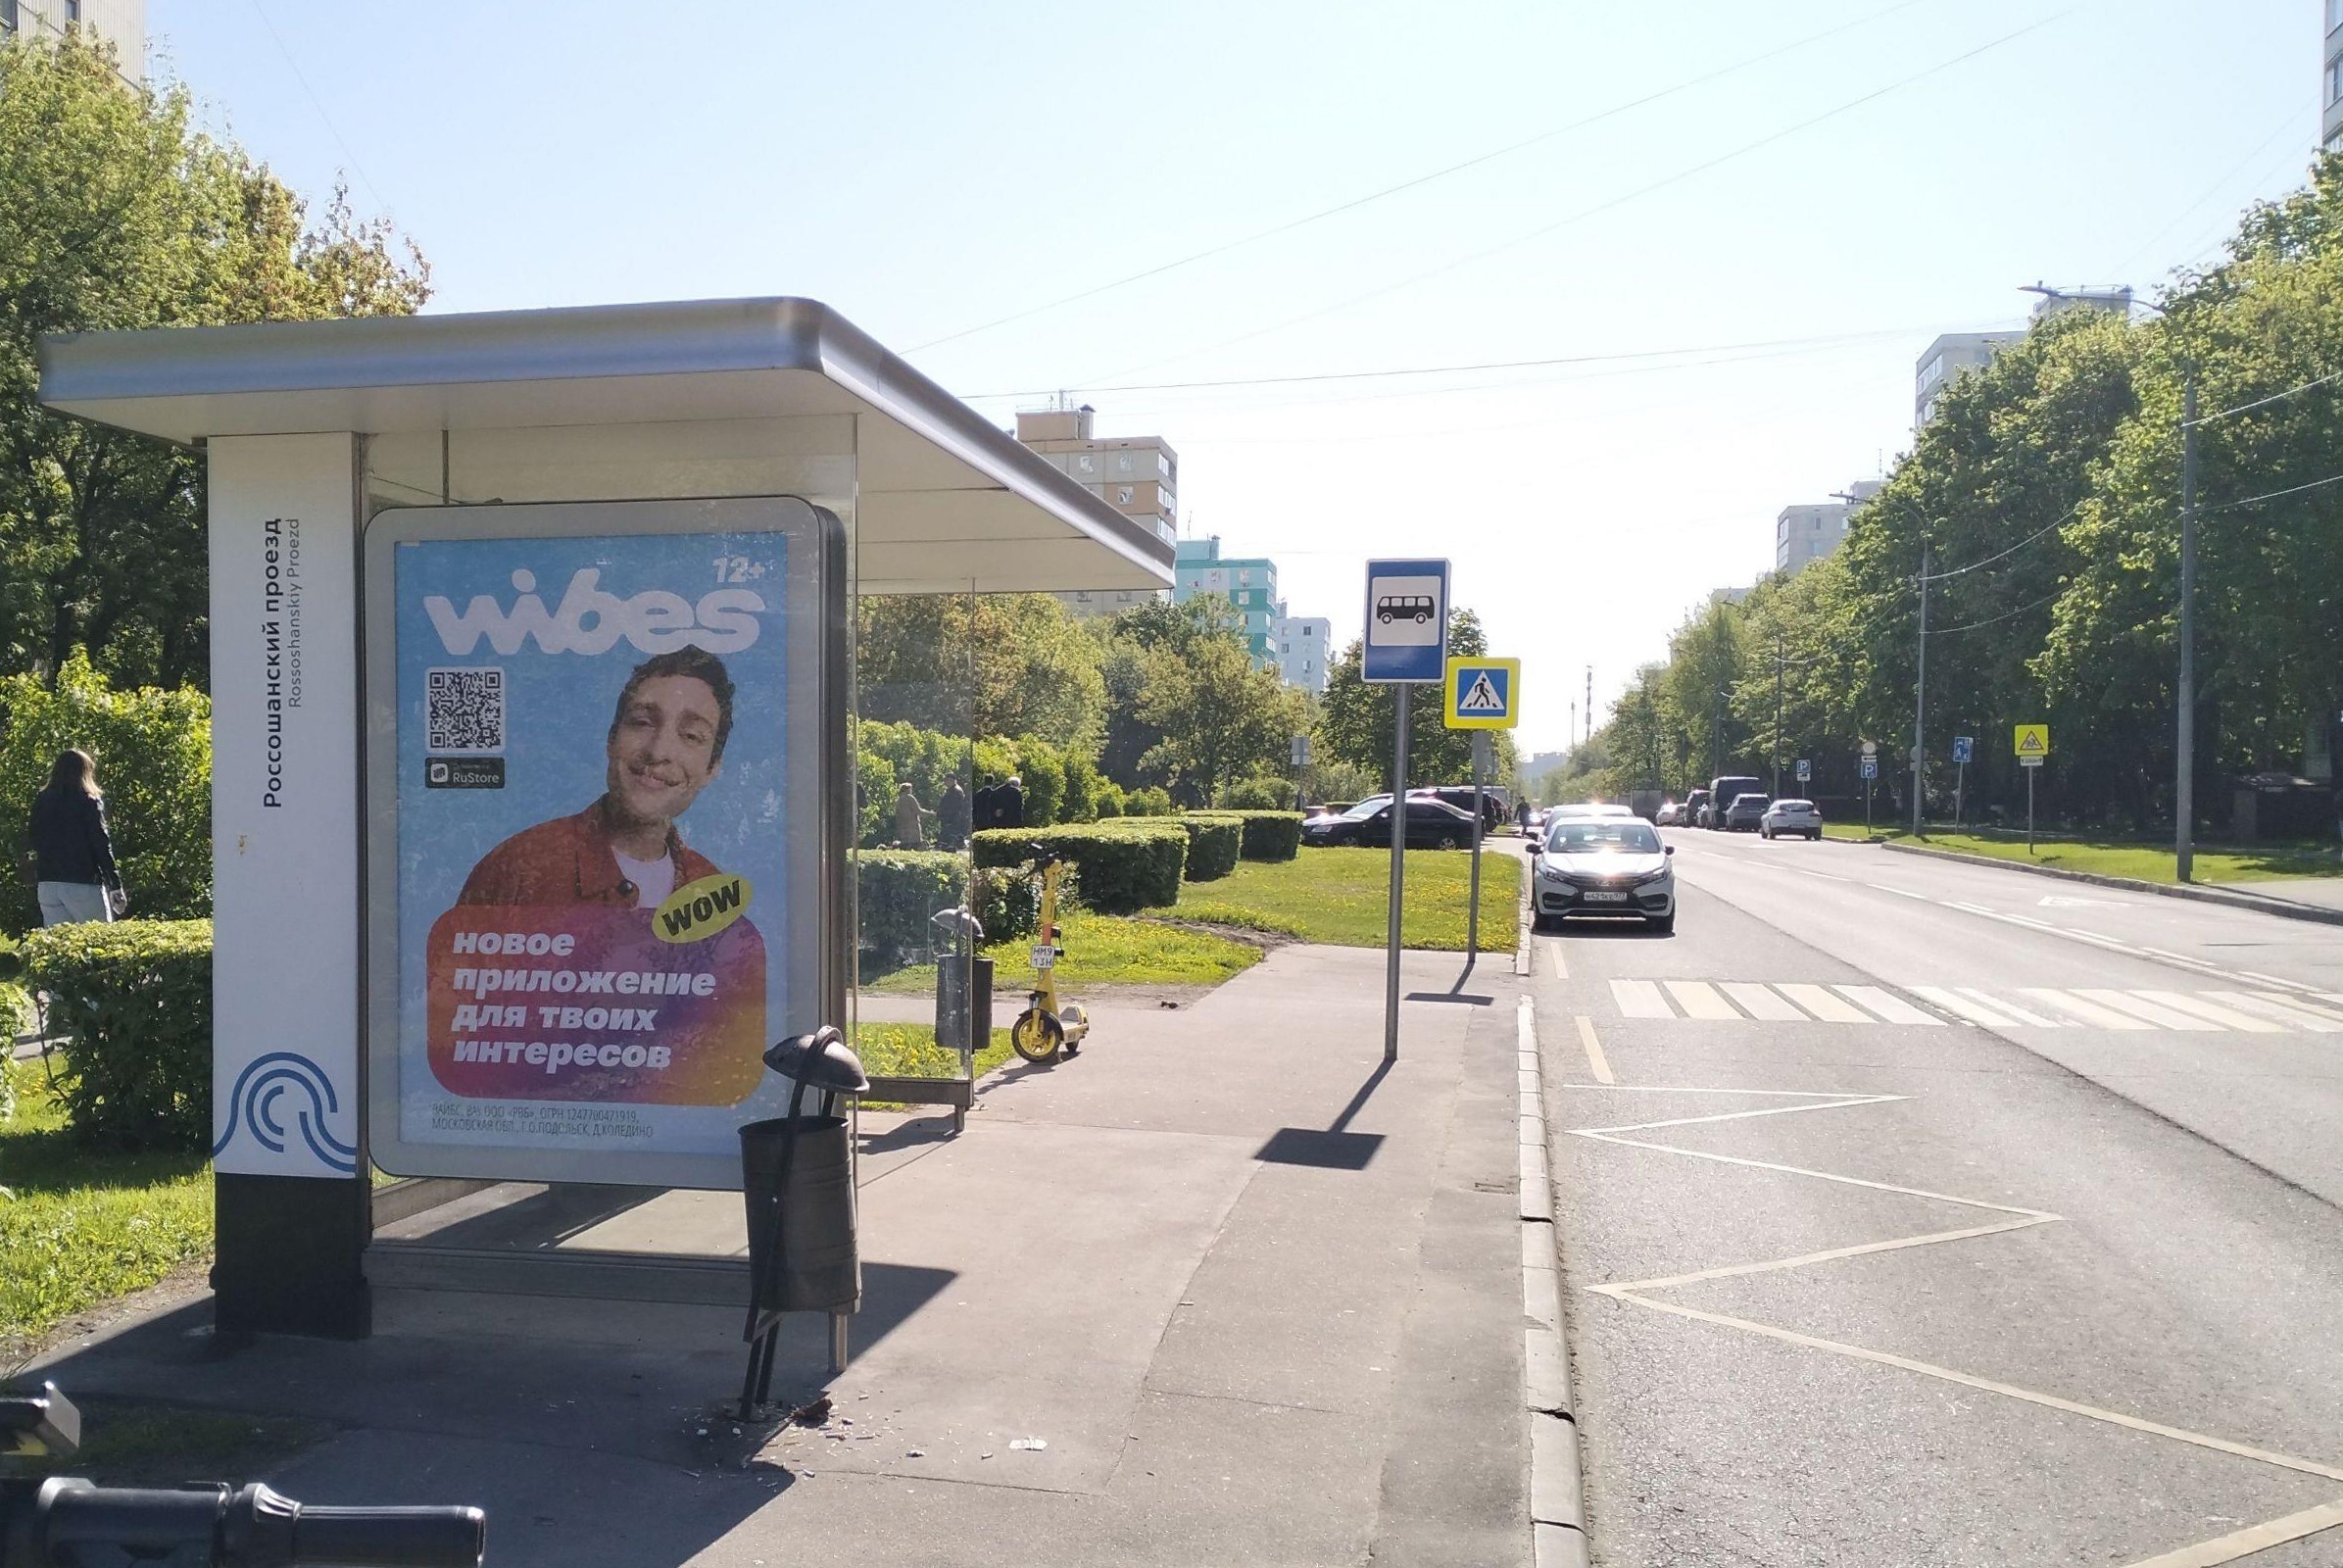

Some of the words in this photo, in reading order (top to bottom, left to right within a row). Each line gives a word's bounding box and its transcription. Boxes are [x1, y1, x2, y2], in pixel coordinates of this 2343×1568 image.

[285, 517, 300, 578] Proezd
[265, 517, 283, 612] проезд
[712, 557, 764, 583] 12+
[422, 567, 766, 657] wibes
[286, 582, 303, 708] Rossoshanskiy
[262, 621, 282, 808] Россошанский
[453, 772, 500, 783] RuStore
[452, 932, 575, 956] новое
[452, 967, 716, 1000] приложение
[451, 1004, 527, 1032] для
[538, 1006, 659, 1031] твоих
[453, 1040, 671, 1074] интересов
[431, 1117, 494, 1131] МОСКОВСКАЯ
[540, 1107, 563, 1119] ОГРН
